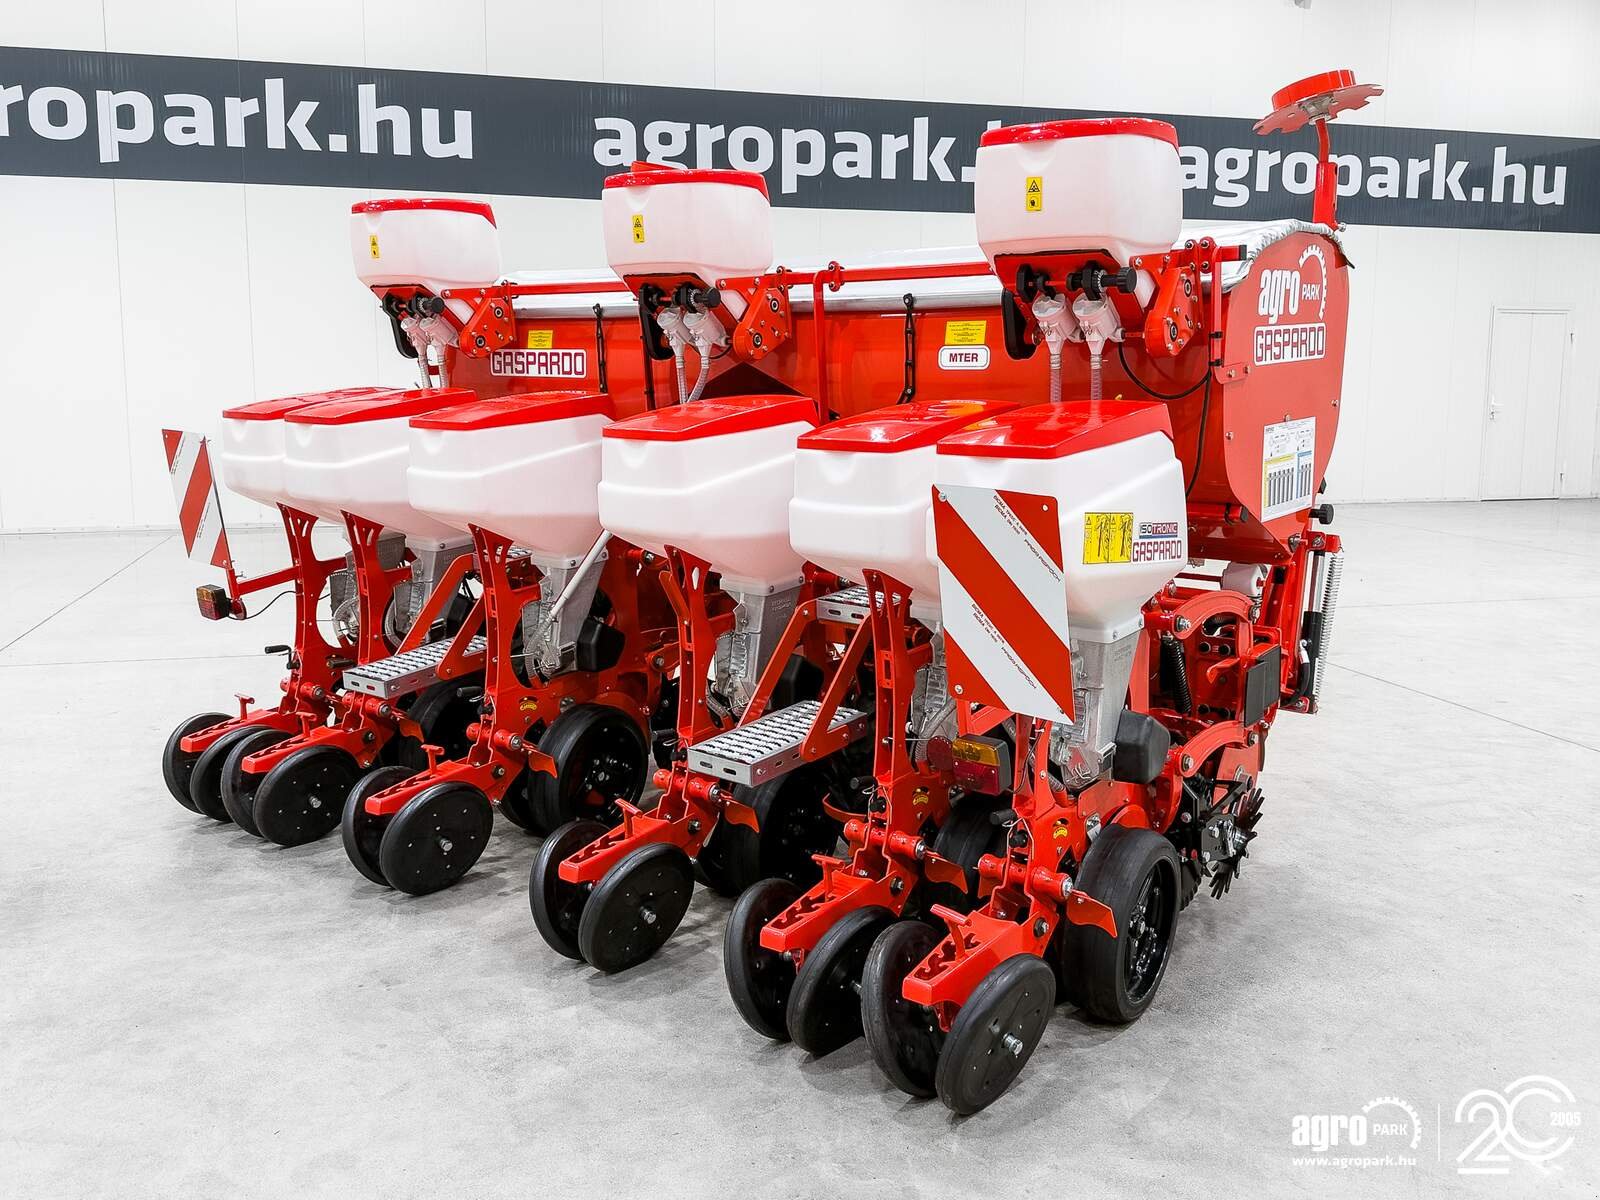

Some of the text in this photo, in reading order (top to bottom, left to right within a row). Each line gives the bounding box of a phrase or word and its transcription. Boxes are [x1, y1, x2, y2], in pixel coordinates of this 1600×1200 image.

[593, 116, 1002, 194] agropark.
[1179, 143, 1568, 208] agropark.hu
[1258, 269, 1321, 325] agro PARK
[949, 352, 979, 363] MTER
[1255, 326, 1325, 363] GASPARDO
[492, 351, 585, 376] GASPARDO
[1139, 522, 1178, 535] ISOTRONIC
[1132, 540, 1182, 563] GASPARDO
